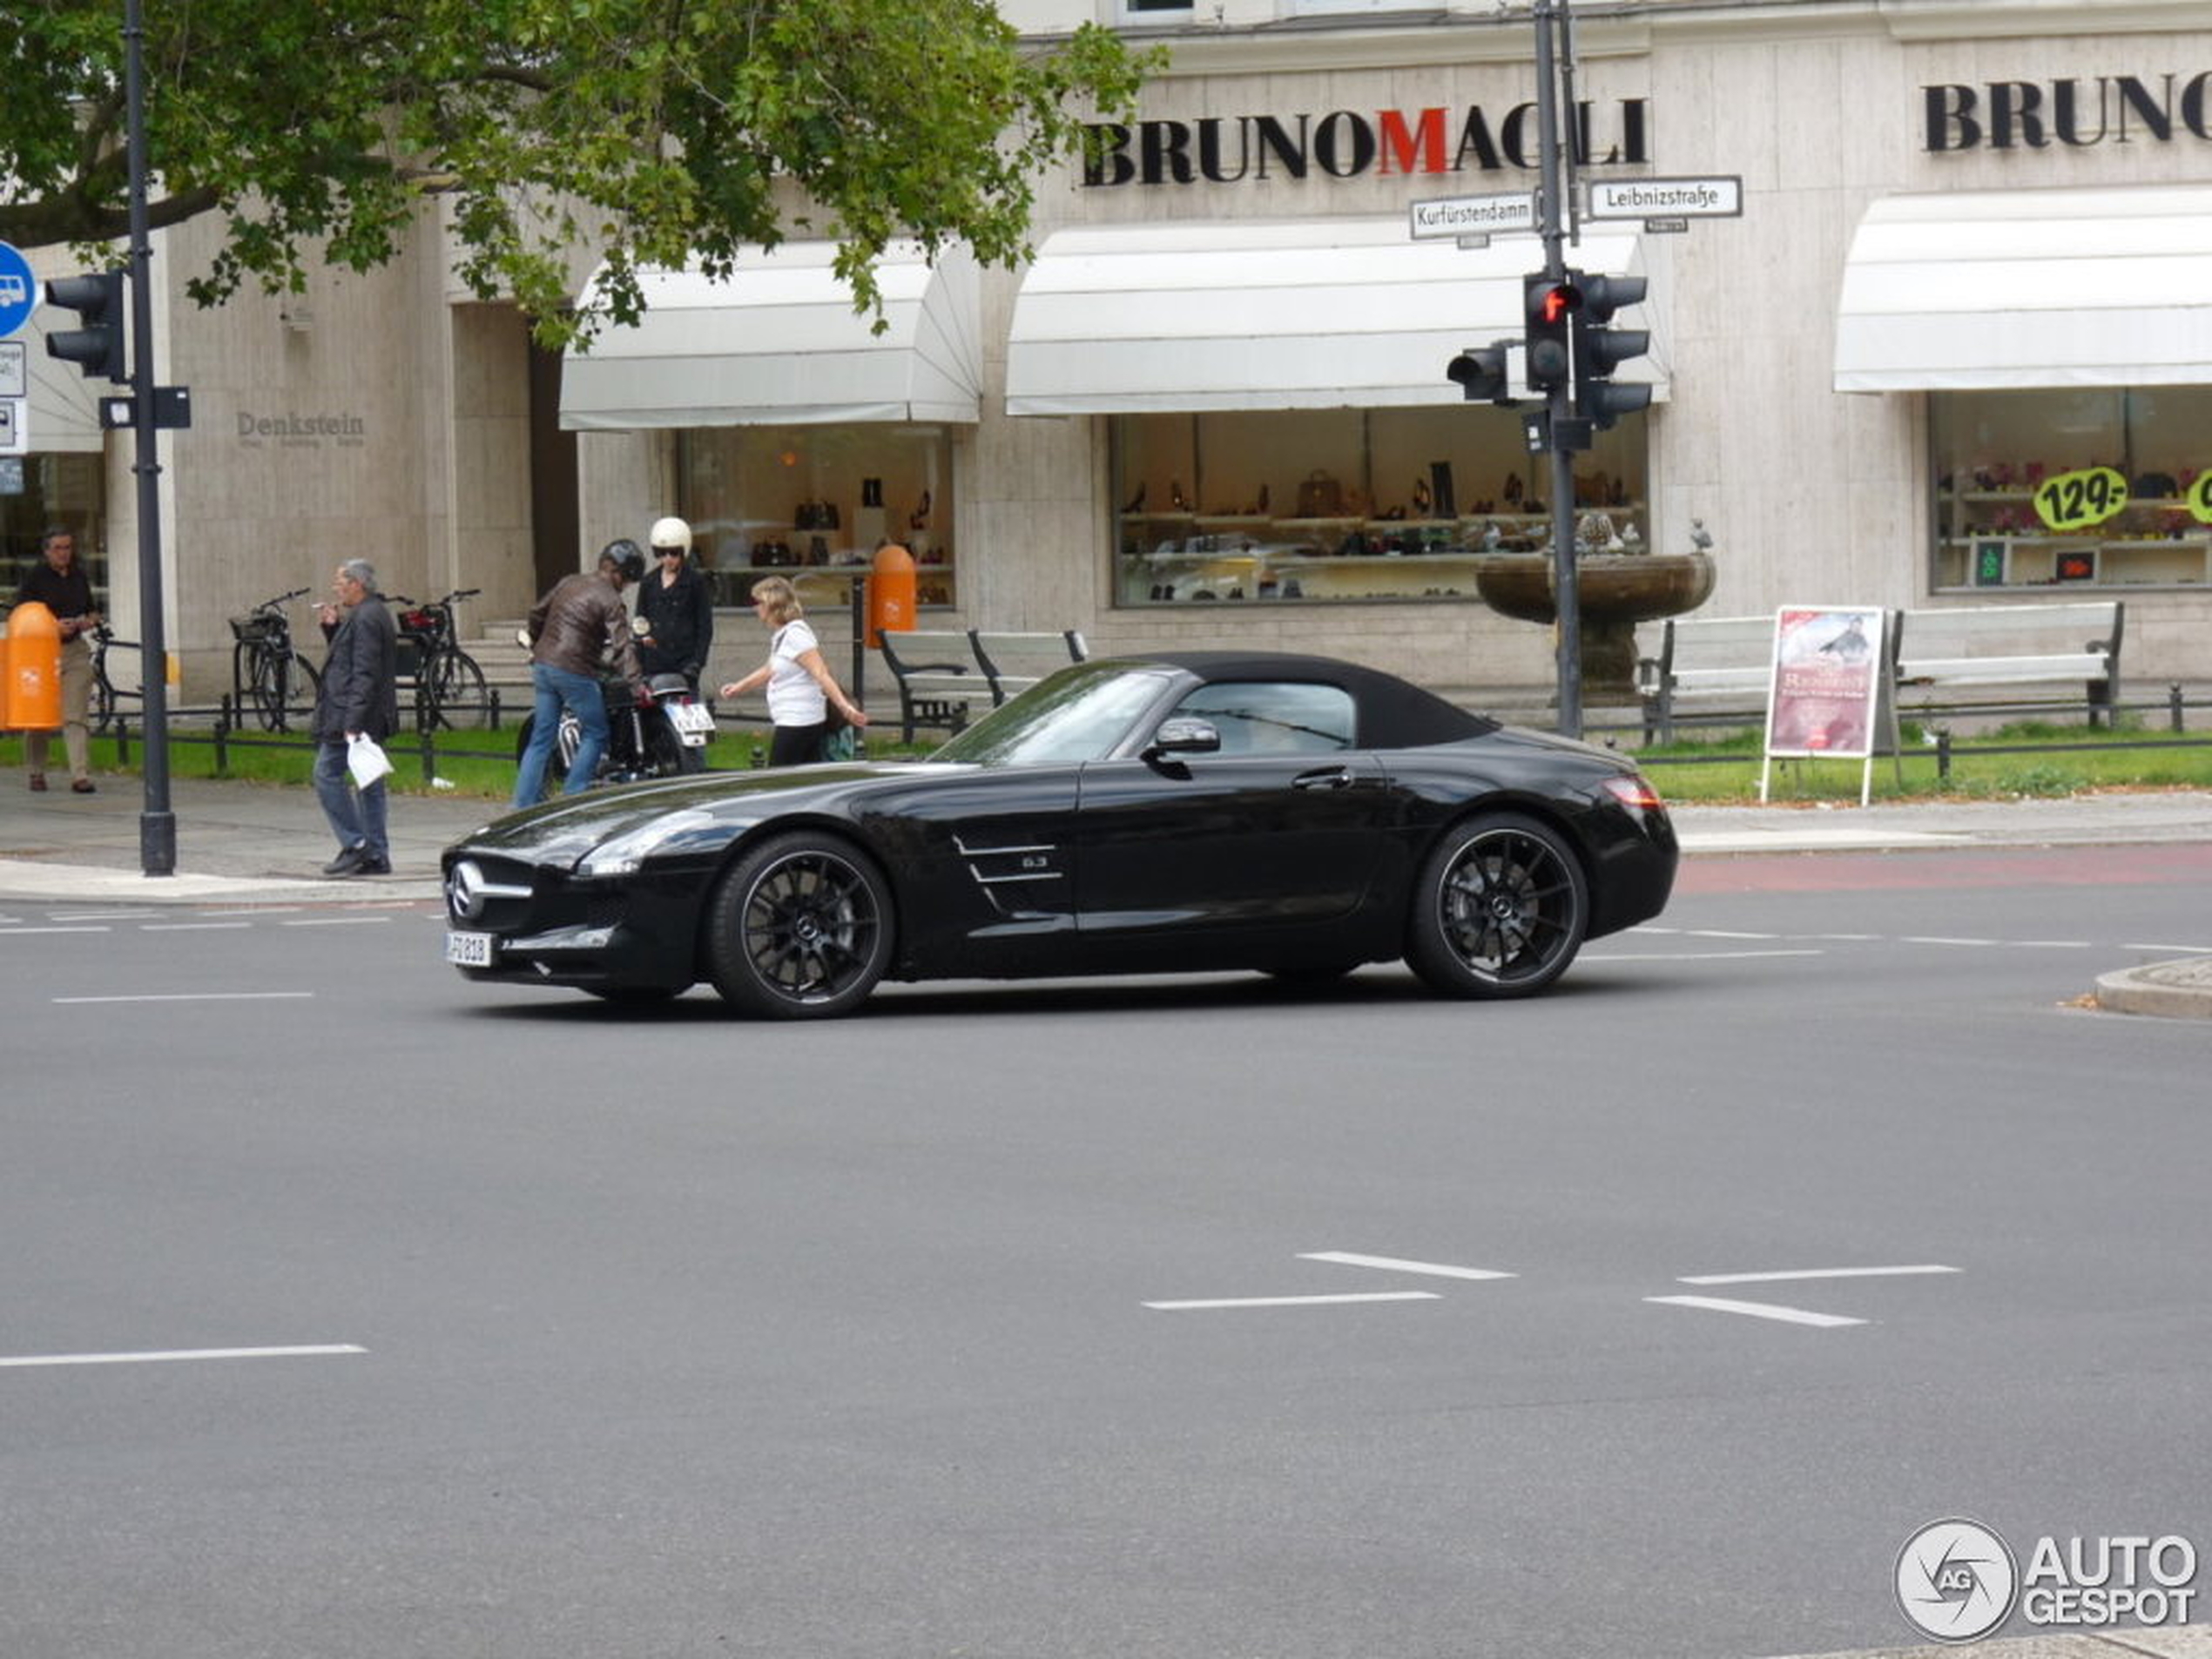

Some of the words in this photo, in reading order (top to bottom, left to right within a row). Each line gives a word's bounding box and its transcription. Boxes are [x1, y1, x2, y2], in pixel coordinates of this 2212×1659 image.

[1607, 185, 1718, 208] Leibnizstraße
[1417, 201, 1529, 226] Kurfürstendamm
[238, 411, 363, 435] Denkstein
